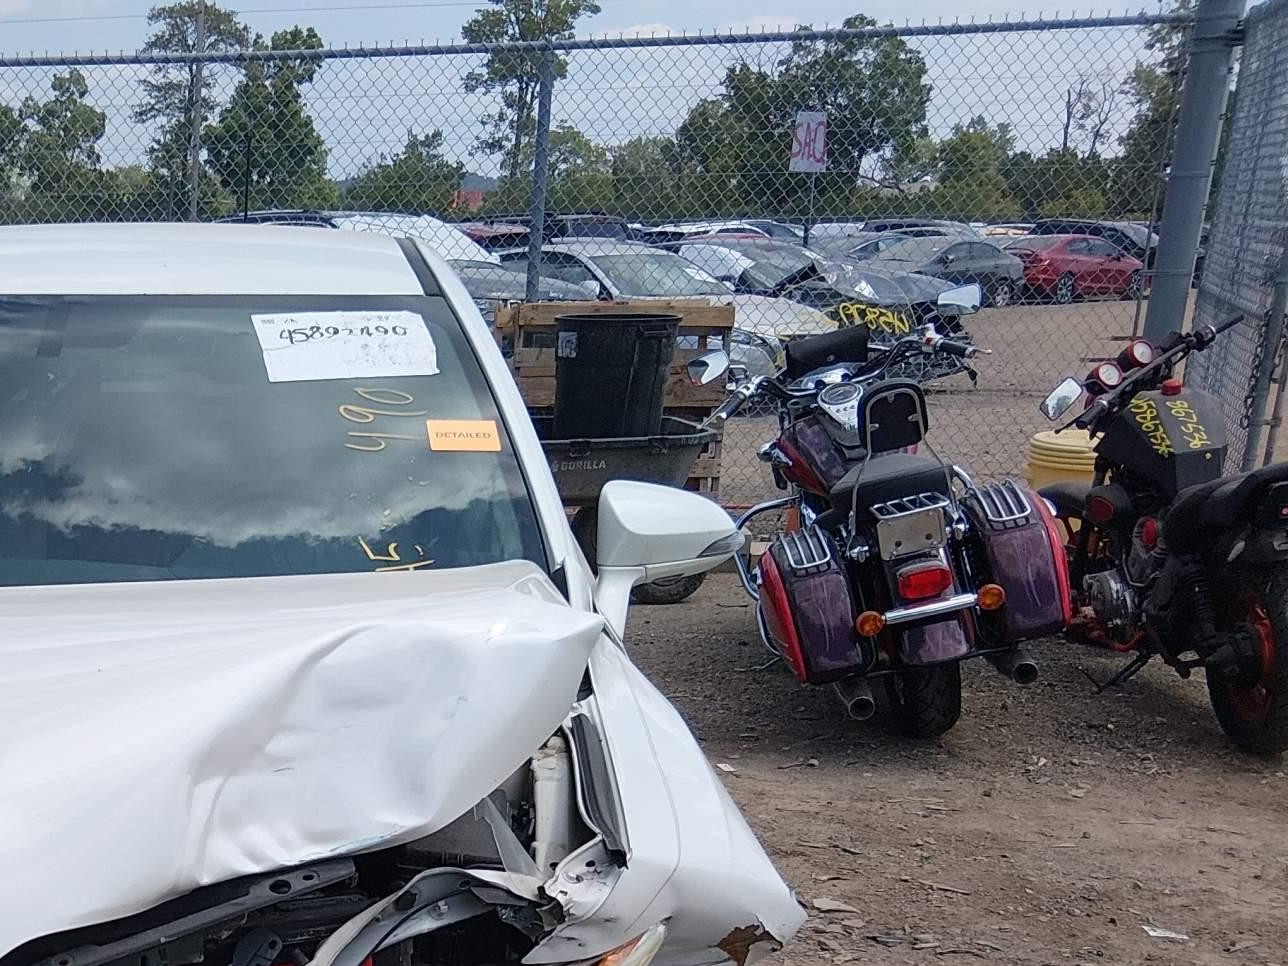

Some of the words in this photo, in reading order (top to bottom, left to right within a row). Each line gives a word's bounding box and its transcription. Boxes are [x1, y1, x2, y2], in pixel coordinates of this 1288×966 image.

[338, 387, 429, 451] 490
[435, 431, 492, 440] DETAILED
[560, 460, 607, 471] GORILLA
